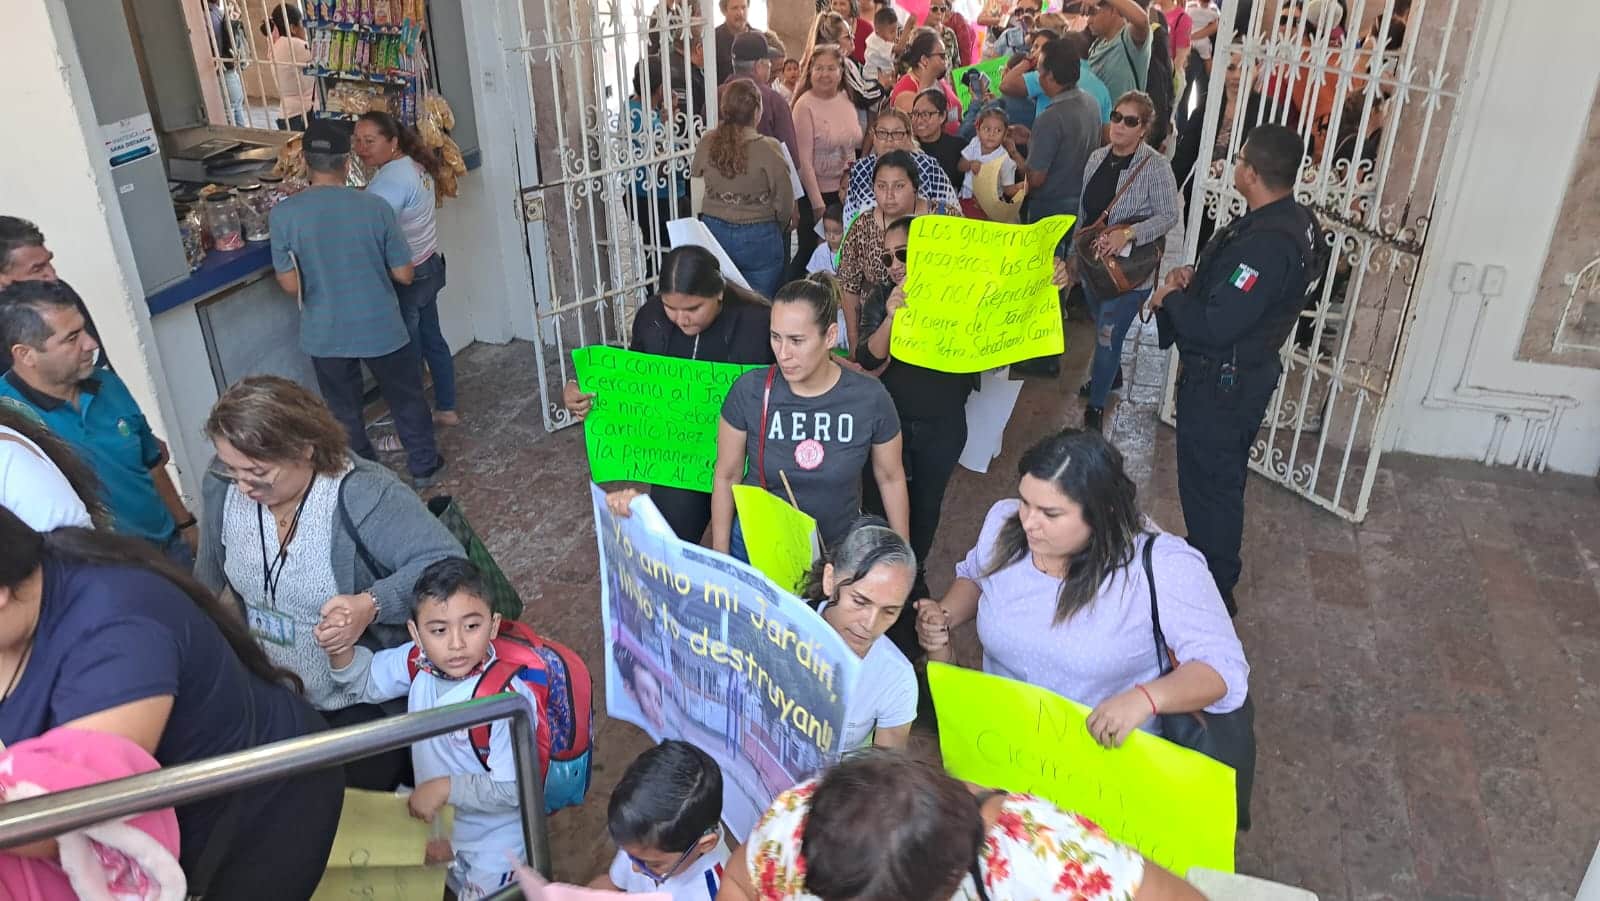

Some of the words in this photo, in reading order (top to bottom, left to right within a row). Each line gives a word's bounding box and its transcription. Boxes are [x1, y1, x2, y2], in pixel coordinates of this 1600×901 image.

[917, 219, 952, 240] Los
[999, 255, 1022, 276] las
[965, 311, 992, 337] del
[586, 347, 616, 370] La
[584, 374, 663, 400] cercana
[671, 383, 691, 401] al
[699, 386, 725, 405] Ja
[618, 399, 661, 419] niños
[667, 399, 719, 425] Seba
[767, 410, 854, 443] AERO
[595, 438, 614, 461] la
[611, 513, 633, 558] Yo
[639, 551, 691, 595] amo
[703, 580, 739, 614] mi
[662, 601, 680, 640] lo
